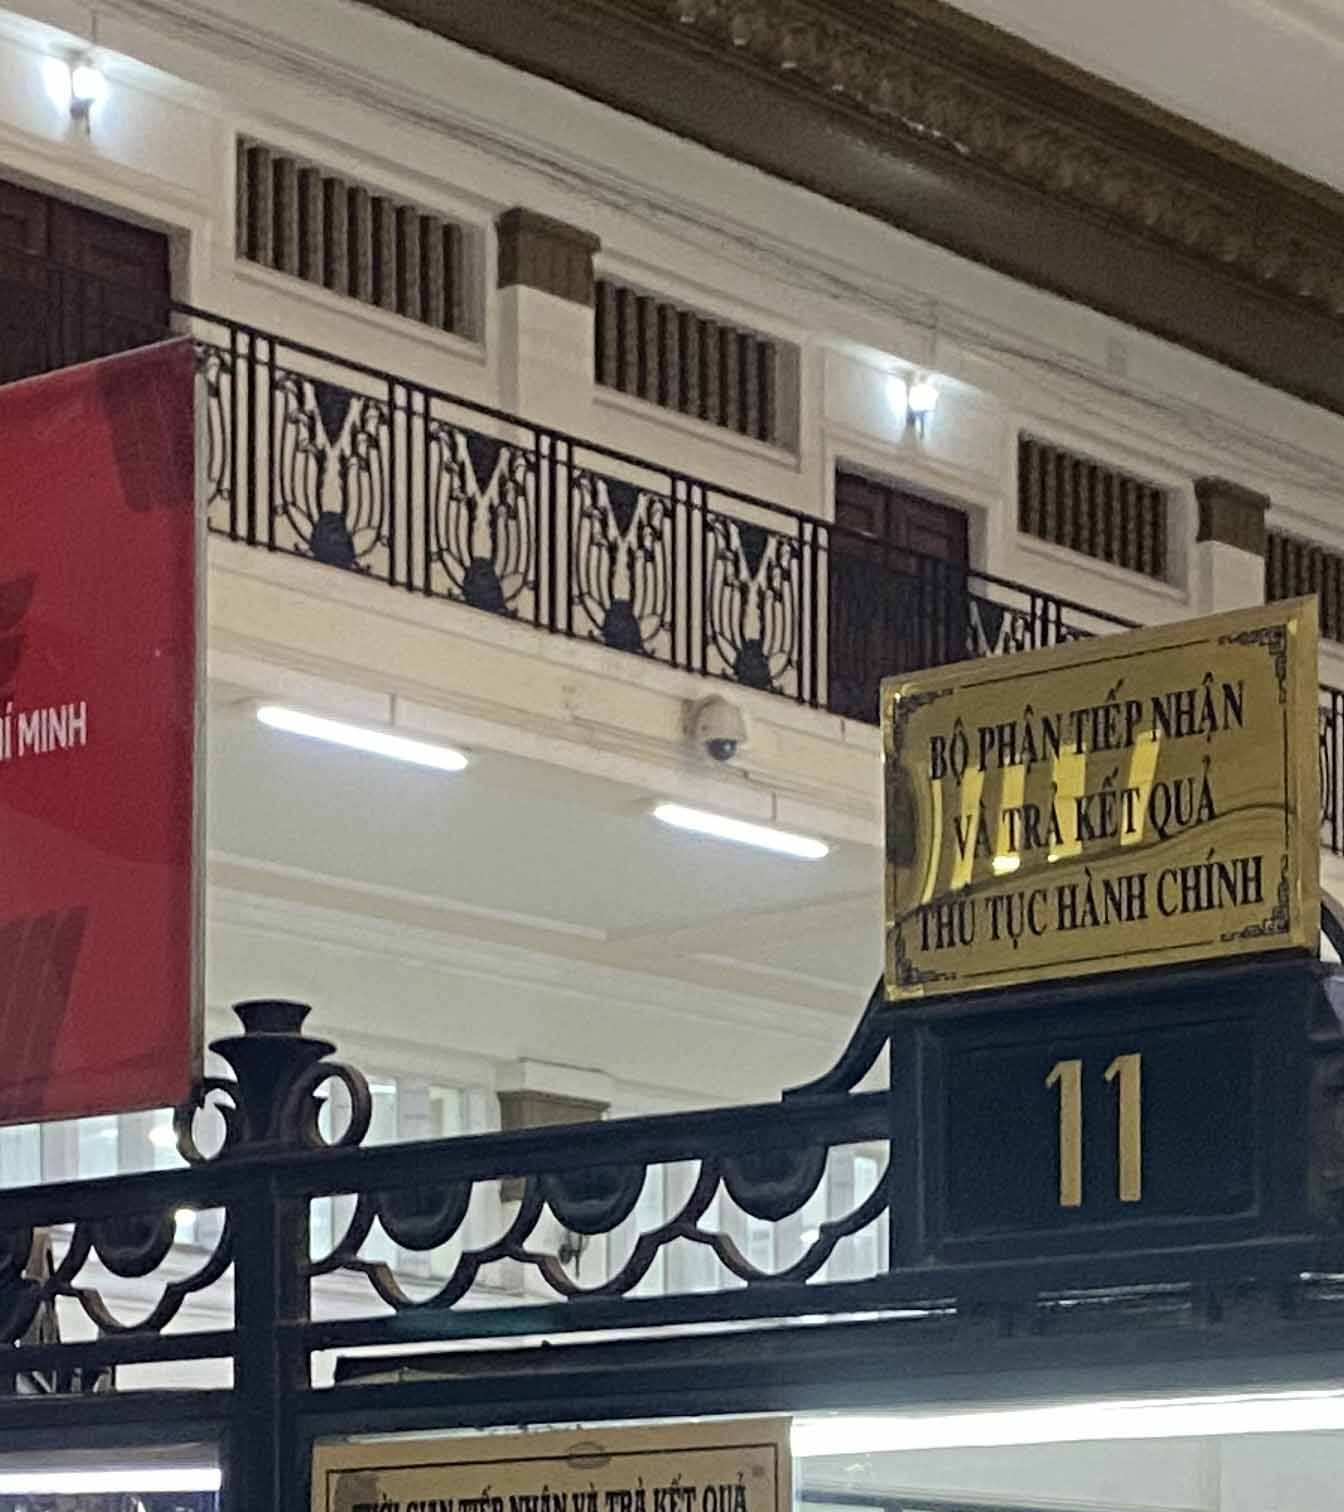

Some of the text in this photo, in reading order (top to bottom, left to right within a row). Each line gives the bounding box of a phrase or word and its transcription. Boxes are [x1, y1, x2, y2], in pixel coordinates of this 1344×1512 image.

[18, 701, 87, 756] MINH
[930, 672, 1244, 786] BỘ PHẬN TIẾP NHẬN
[954, 755, 1218, 862] VÀ TRẢ KẾT QUẢ
[985, 889, 1049, 949] TỤC
[1055, 867, 1149, 931] HÀNH
[1157, 848, 1264, 917] CHÍNH
[1045, 1052, 1144, 1208] 11
